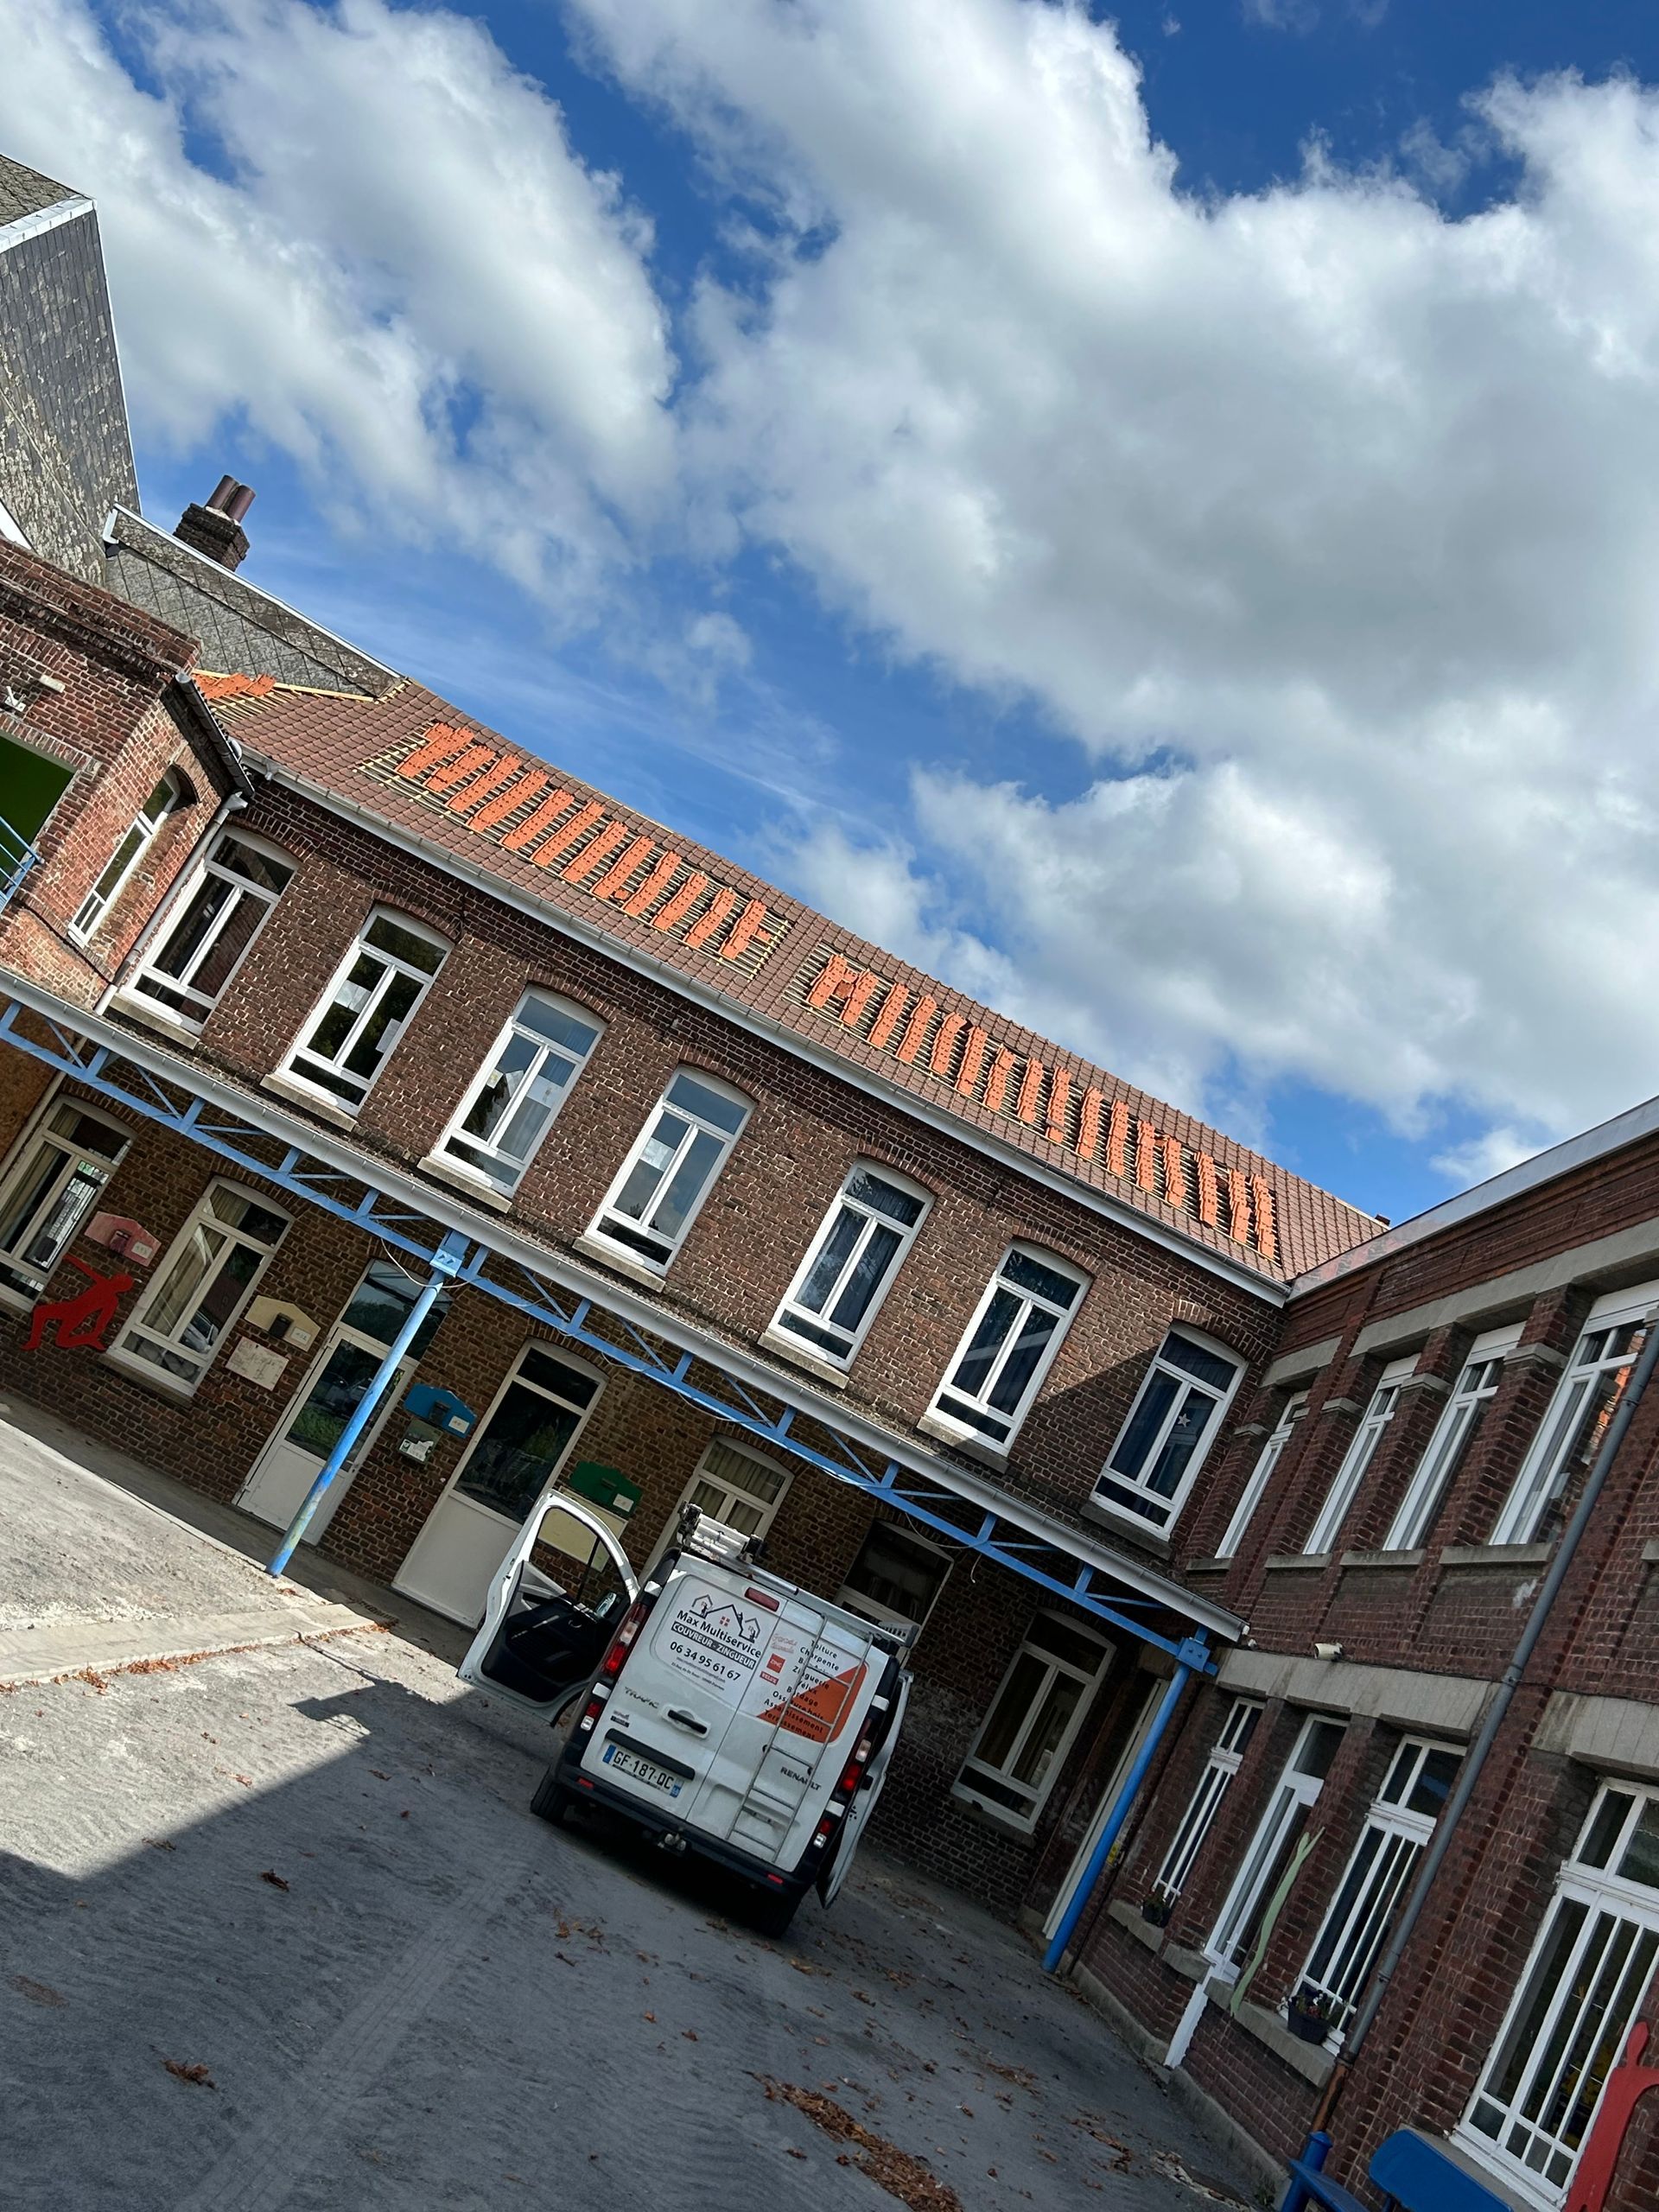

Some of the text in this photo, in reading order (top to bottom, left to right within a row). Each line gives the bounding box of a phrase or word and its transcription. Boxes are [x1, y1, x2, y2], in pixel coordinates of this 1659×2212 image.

[673, 1624, 714, 1648] COUVREUR
[717, 1645, 755, 1669] ZINGUEUR
[677, 1610, 699, 1627] Max
[700, 1621, 761, 1658] Multiservice
[670, 1641, 683, 1654] 06
[683, 1649, 698, 1661] 34
[698, 1655, 713, 1668] 95
[713, 1662, 726, 1675] 61
[727, 1669, 741, 1681] 67
[786, 1686, 818, 1707] Brdage
[765, 1710, 816, 1740] Terrssement
